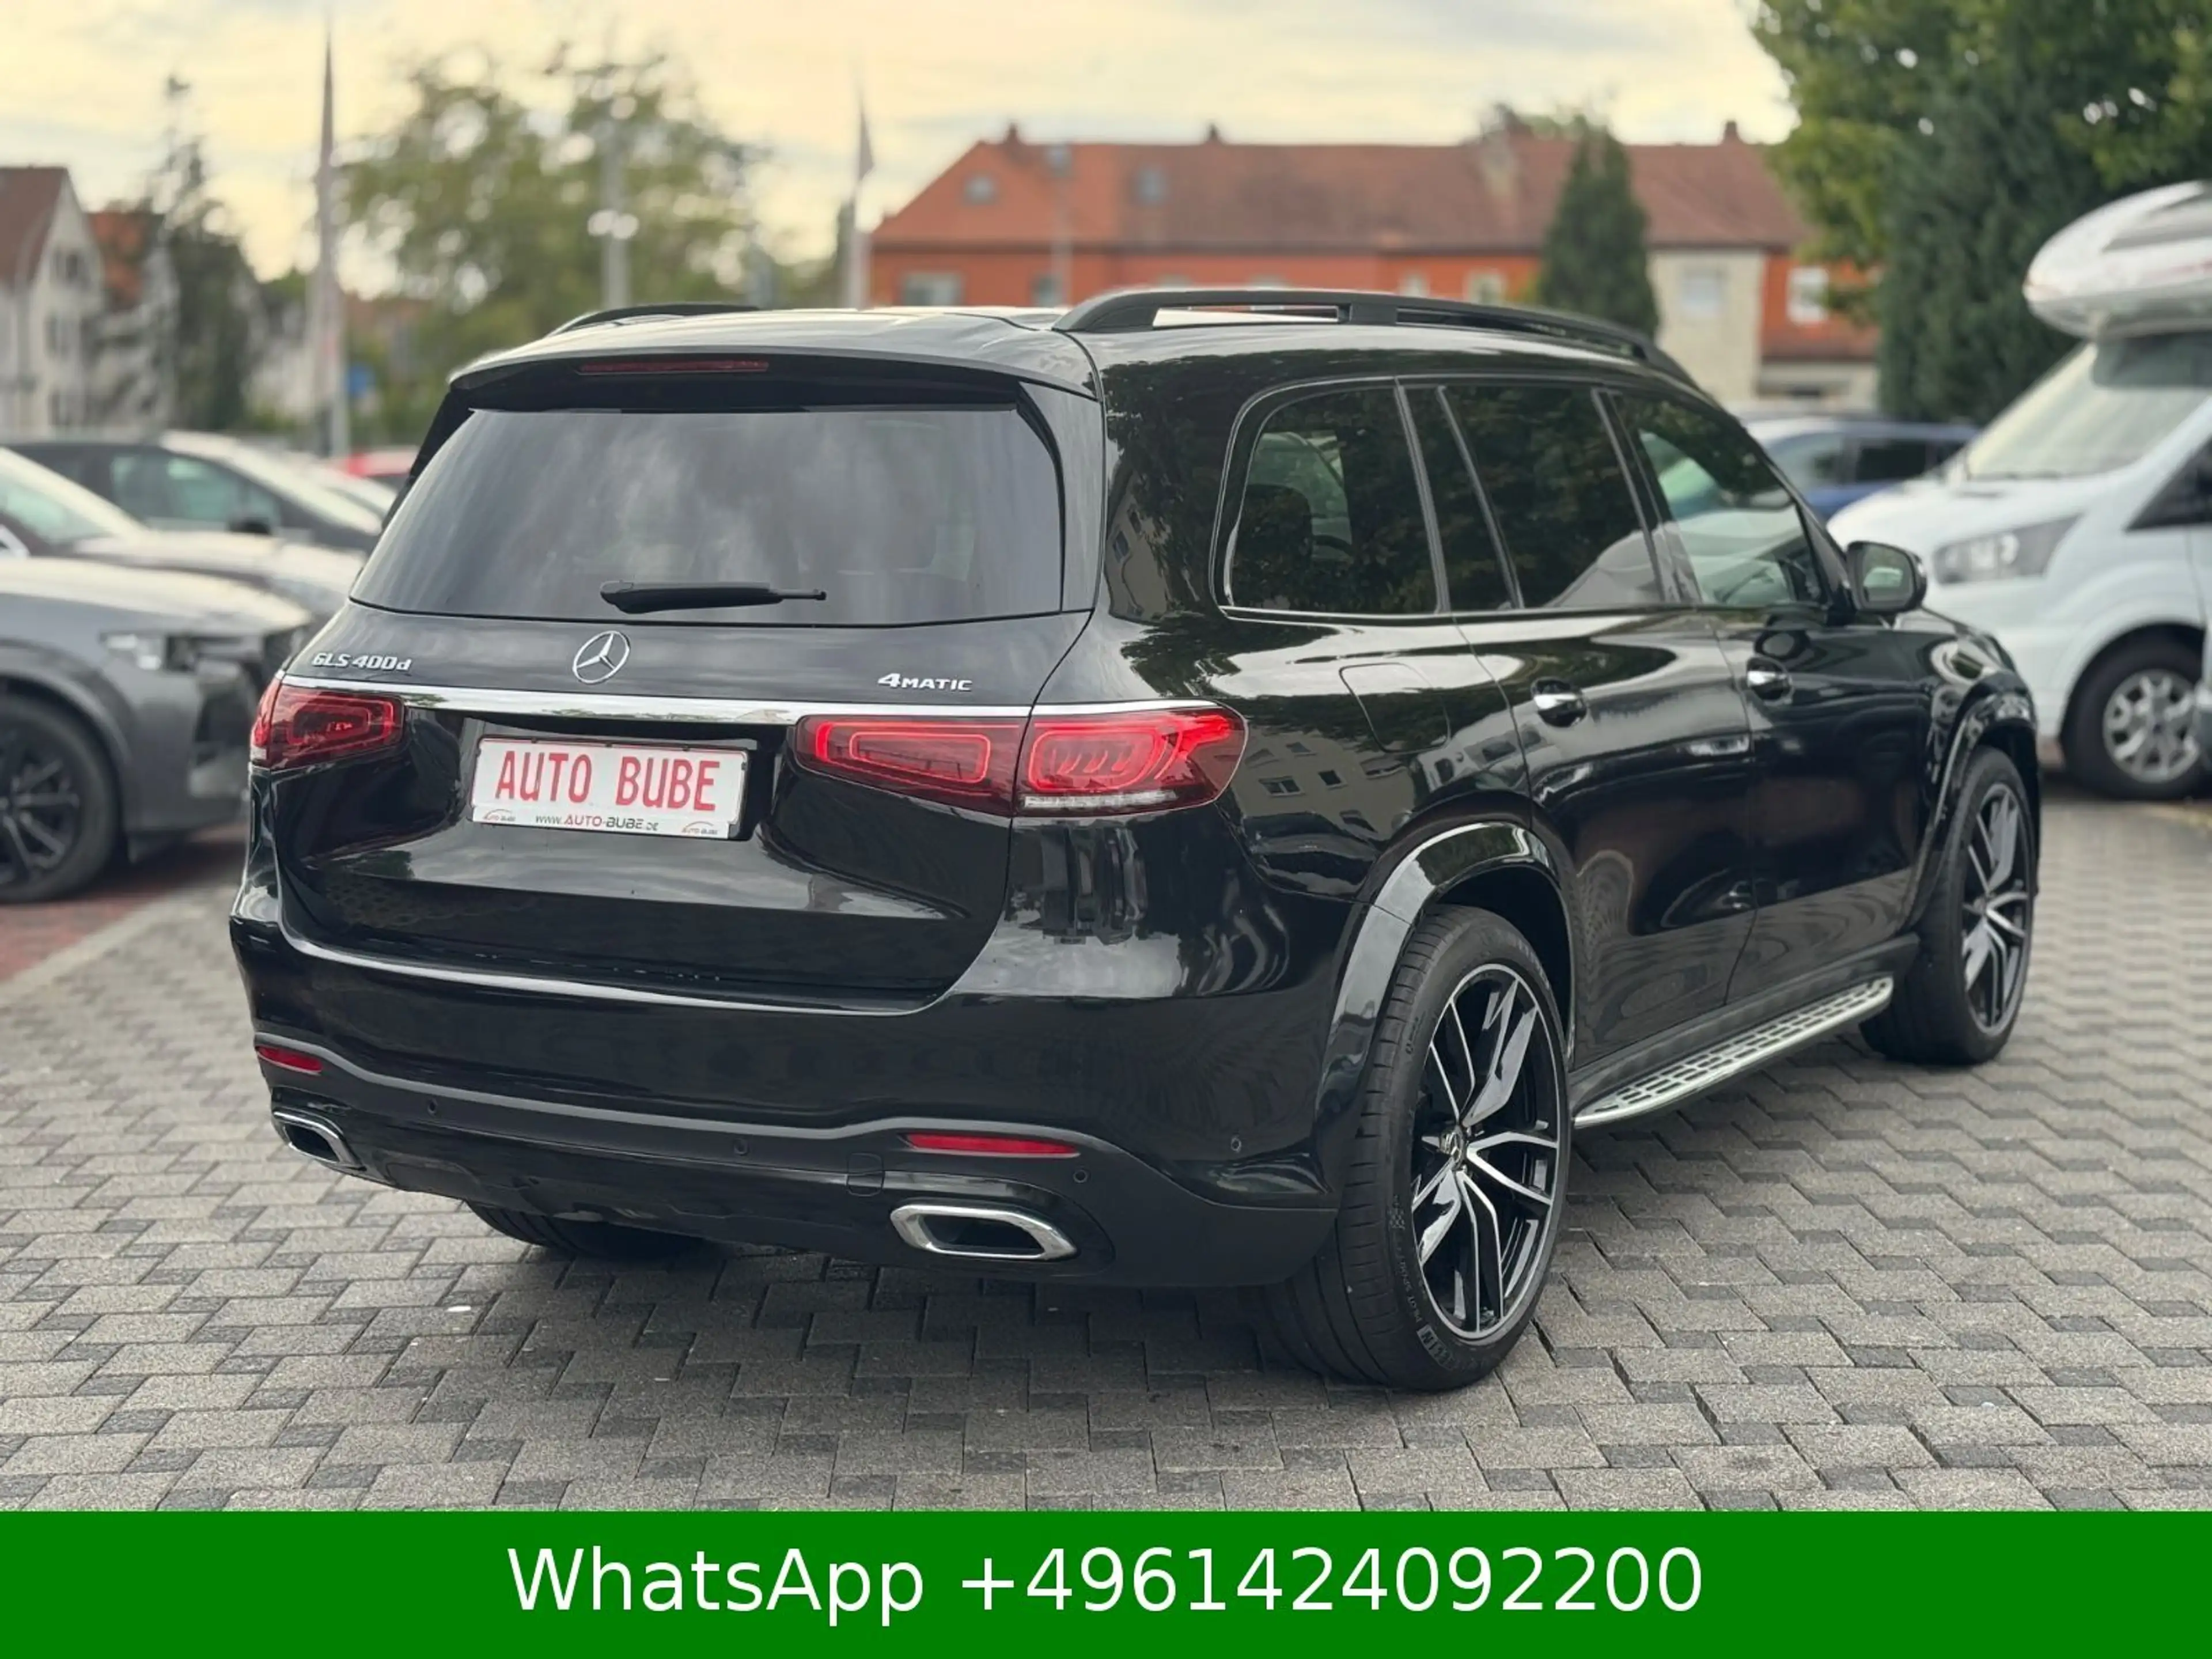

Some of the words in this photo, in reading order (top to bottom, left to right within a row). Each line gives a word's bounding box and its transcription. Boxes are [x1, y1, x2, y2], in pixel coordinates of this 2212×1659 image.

[312, 652, 351, 667] GLS
[351, 655, 412, 671] 400d
[877, 672, 973, 691] 4MATIC
[495, 751, 593, 803] AUTO
[615, 756, 720, 812] BUBE
